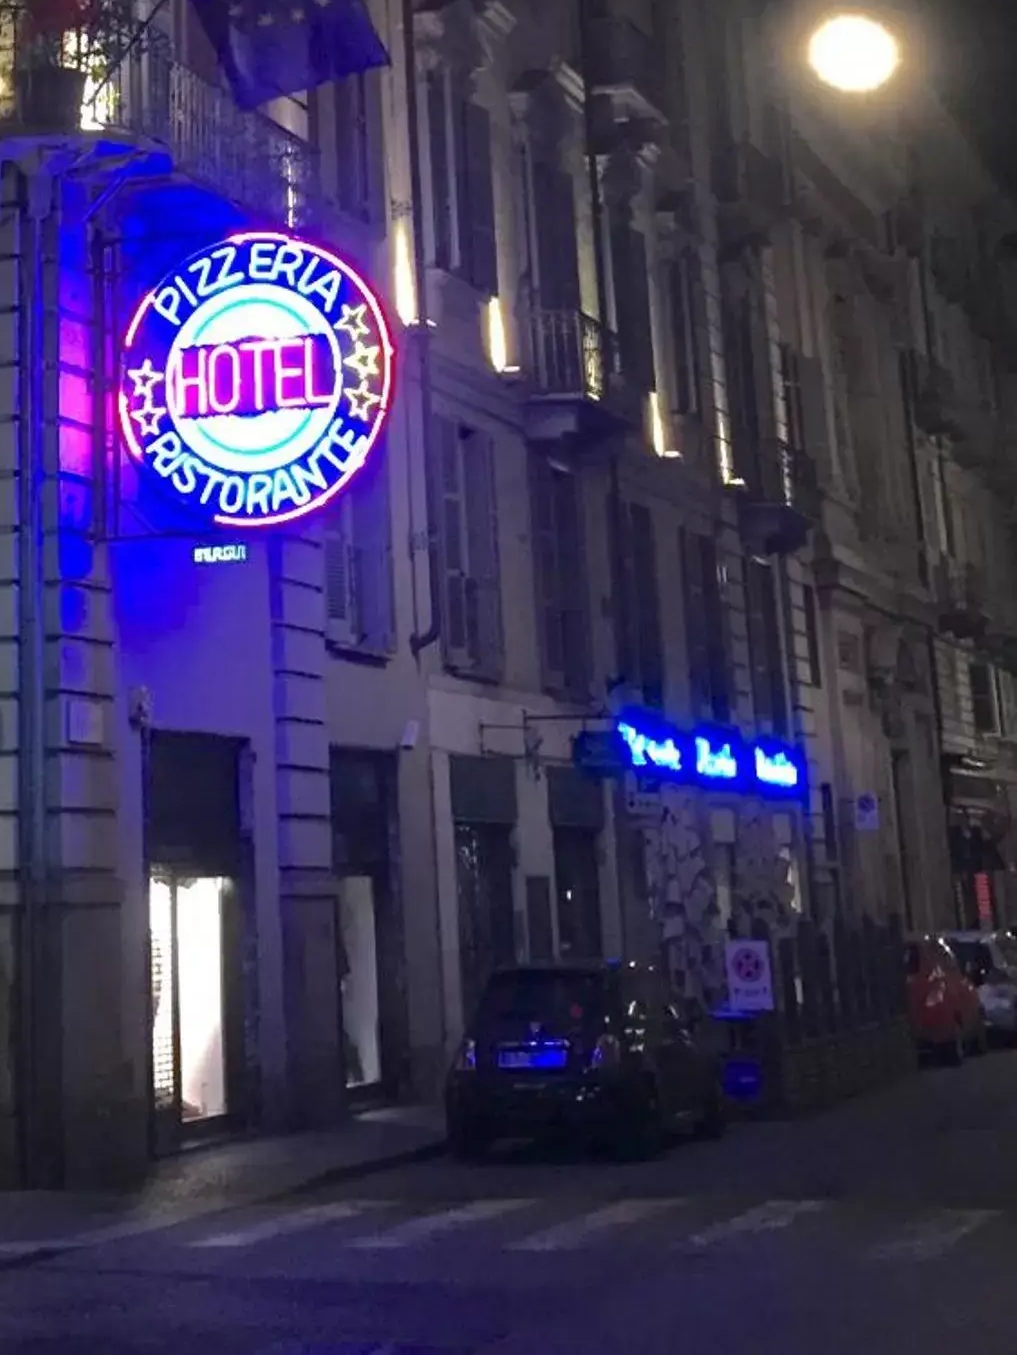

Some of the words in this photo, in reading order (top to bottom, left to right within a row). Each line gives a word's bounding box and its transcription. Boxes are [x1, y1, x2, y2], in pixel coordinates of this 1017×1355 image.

[152, 242, 342, 325] PIZZERIA
[177, 337, 334, 416] HOTEL
[146, 416, 367, 515] RISTORANTE
